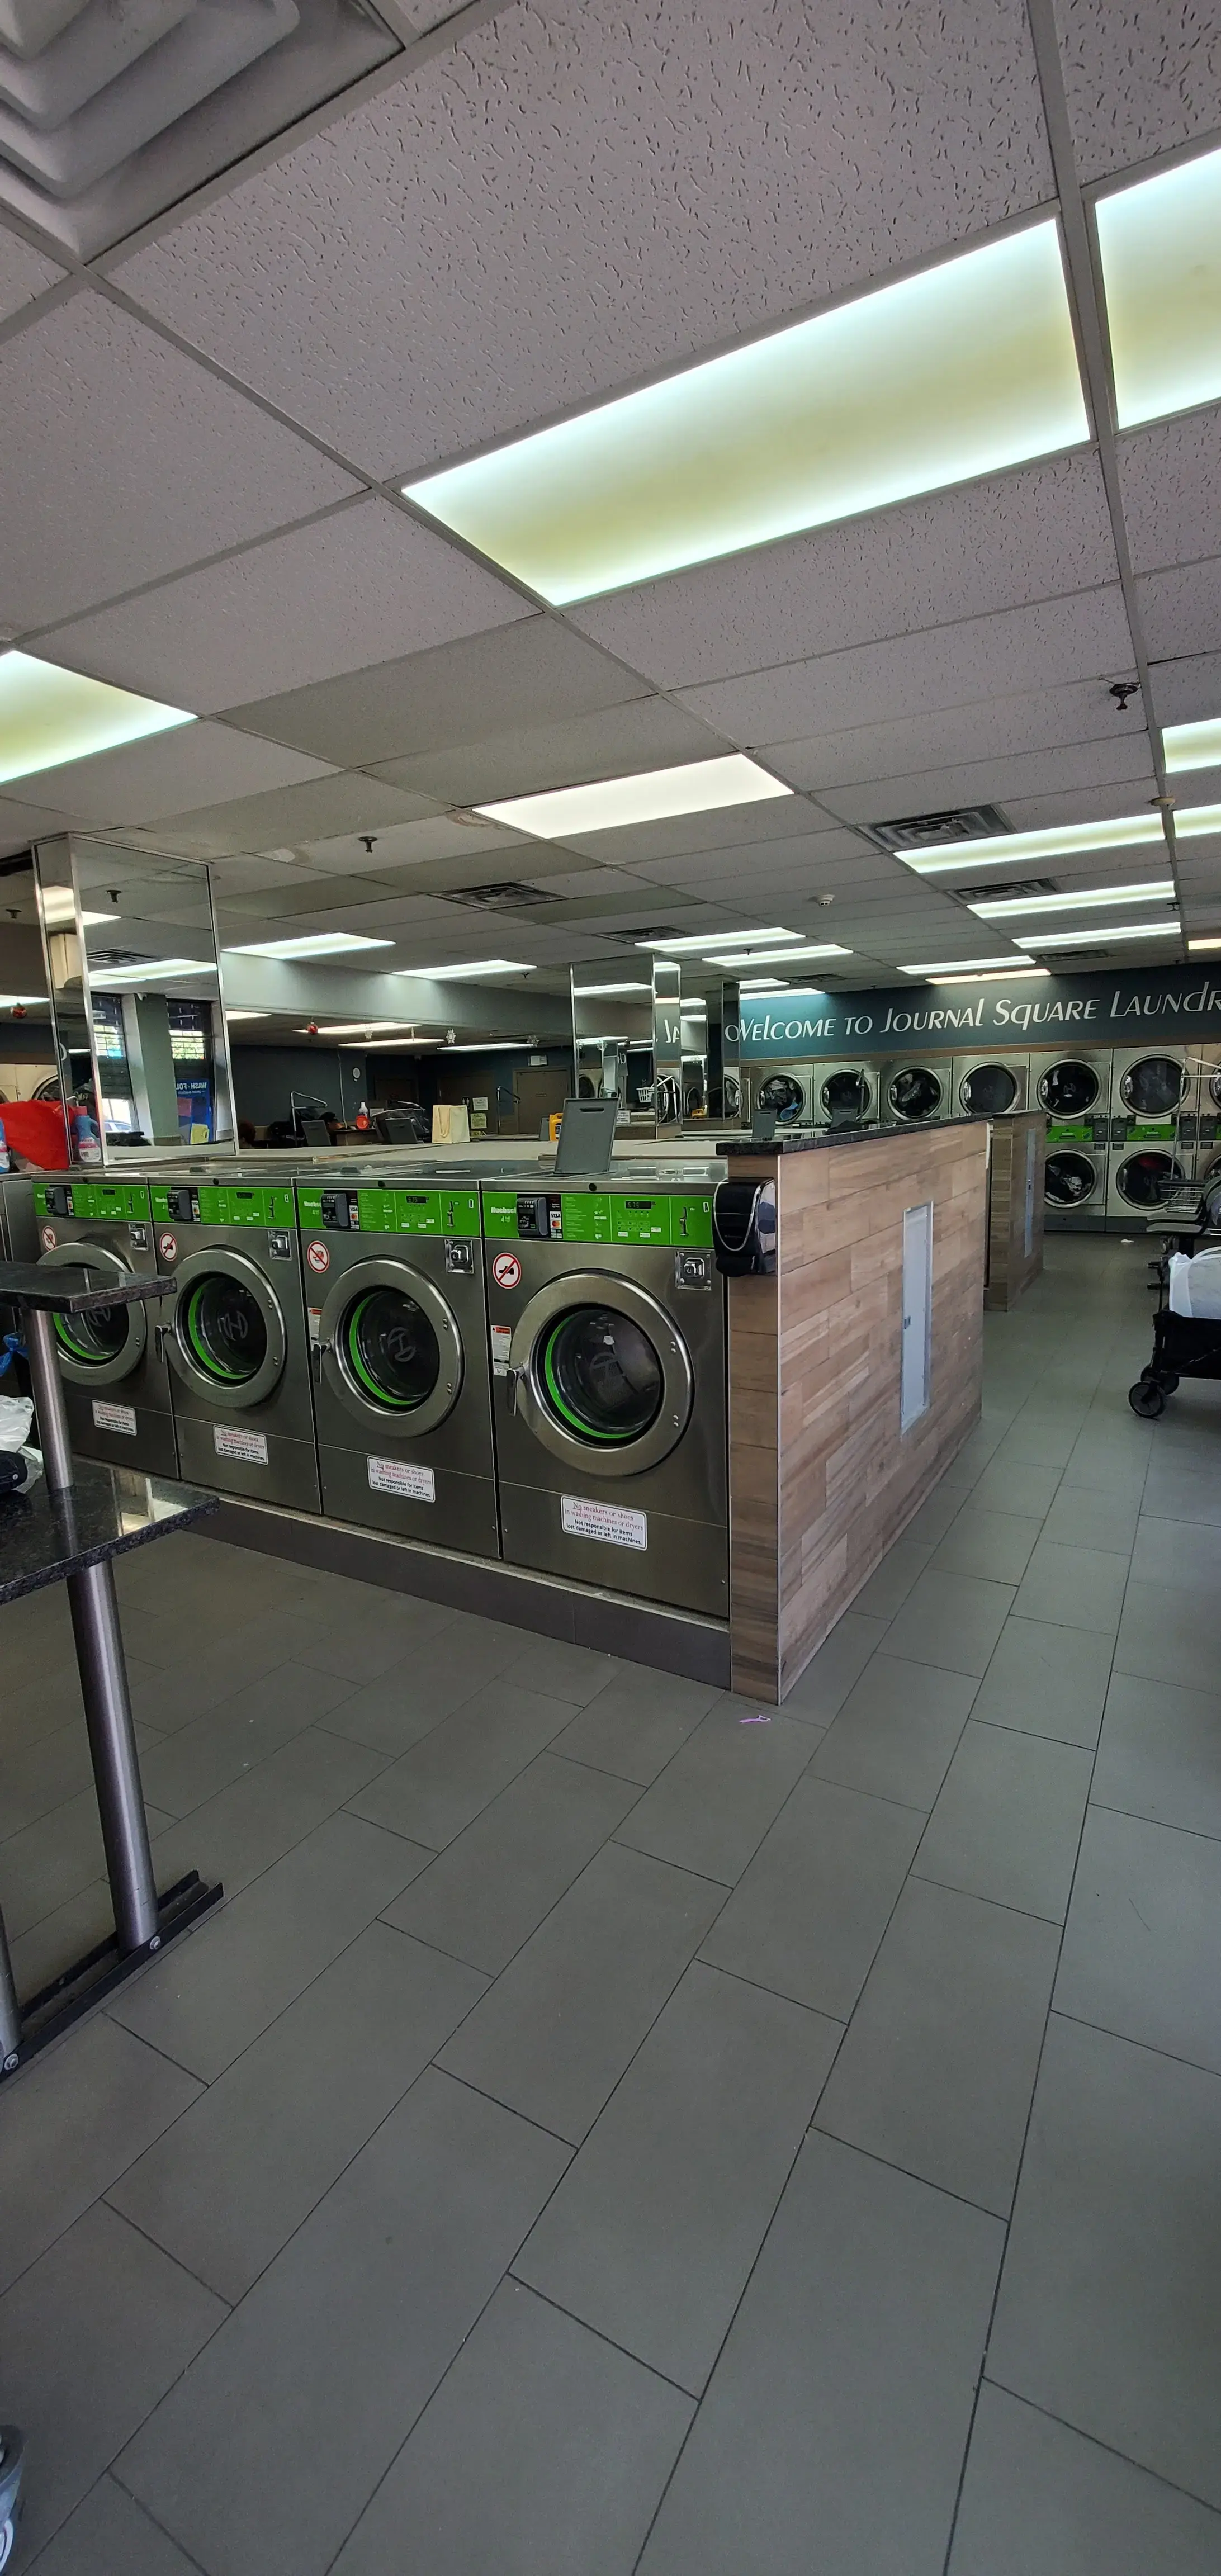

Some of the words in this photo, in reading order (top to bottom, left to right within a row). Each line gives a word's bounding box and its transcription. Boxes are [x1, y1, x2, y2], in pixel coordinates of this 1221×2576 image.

[571, 1510, 591, 1522] washing
[593, 1516, 617, 1525] machines
[626, 1522, 643, 1531] dryers
[572, 1502, 582, 1511] No
[584, 1506, 608, 1515] sneakers
[618, 1512, 633, 1521] shoes
[576, 1526, 597, 1535] damaged
[618, 1535, 642, 1545] machines.
[584, 1522, 610, 1531] responsible
